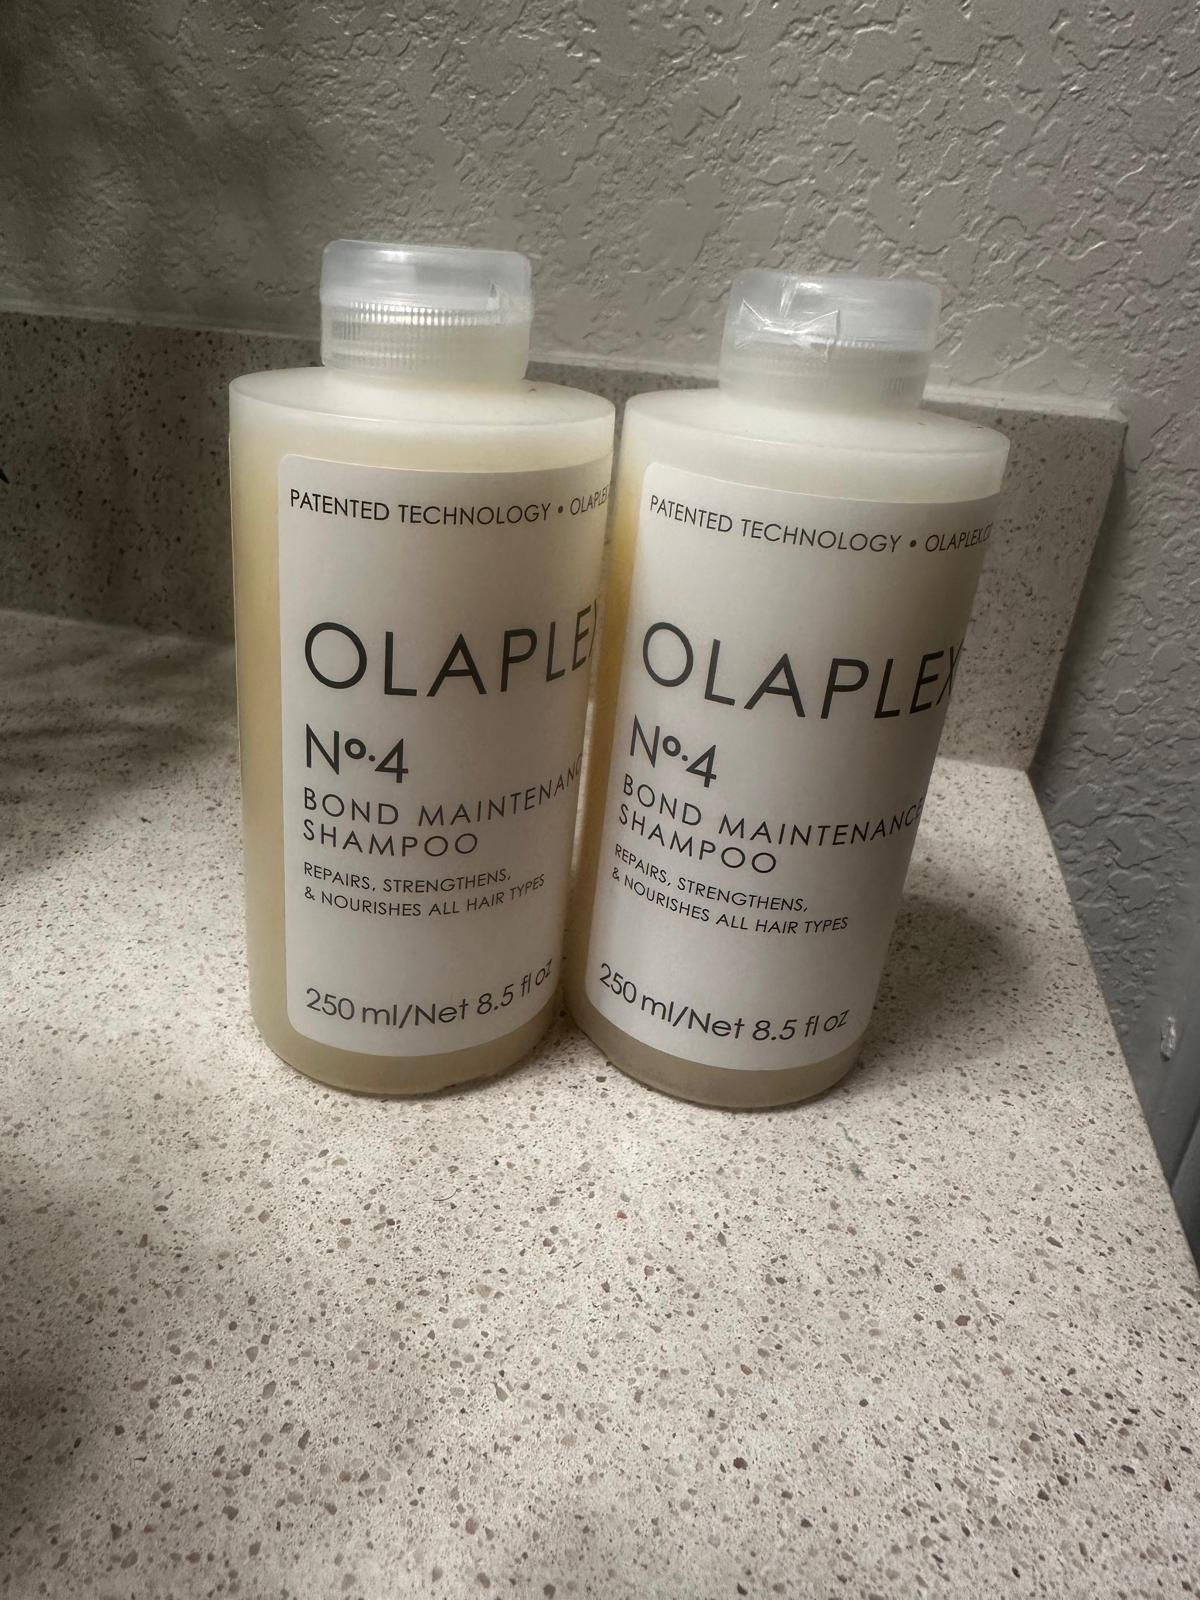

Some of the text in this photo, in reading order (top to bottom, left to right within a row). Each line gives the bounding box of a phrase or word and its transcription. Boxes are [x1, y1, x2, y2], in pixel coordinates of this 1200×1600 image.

[290, 488, 390, 521] PATENTED
[398, 502, 551, 526] TECHNOLOGY
[650, 494, 733, 533] PATENTED
[741, 518, 902, 553] TECHNOLOGY
[643, 621, 964, 719] OLAPLEX
[304, 787, 399, 825] BOND
[623, 774, 702, 827] BOND
[303, 819, 478, 857] SHAMPOO
[619, 804, 777, 874] SHAMPOO
[304, 862, 512, 893] REPAIRS, STRENGTHENS,
[304, 874, 545, 917] & NOURISHES ALL HAIR TYPES
[612, 867, 849, 935] & NOURISHES ALL HAIR TYPES
[615, 844, 809, 913] REPAIRS, STRENGTHENS,
[306, 959, 552, 1029] 250 ml/Net 8.5 fl oz
[600, 963, 850, 1041] 250 ml/Net 8.5 fl oz
